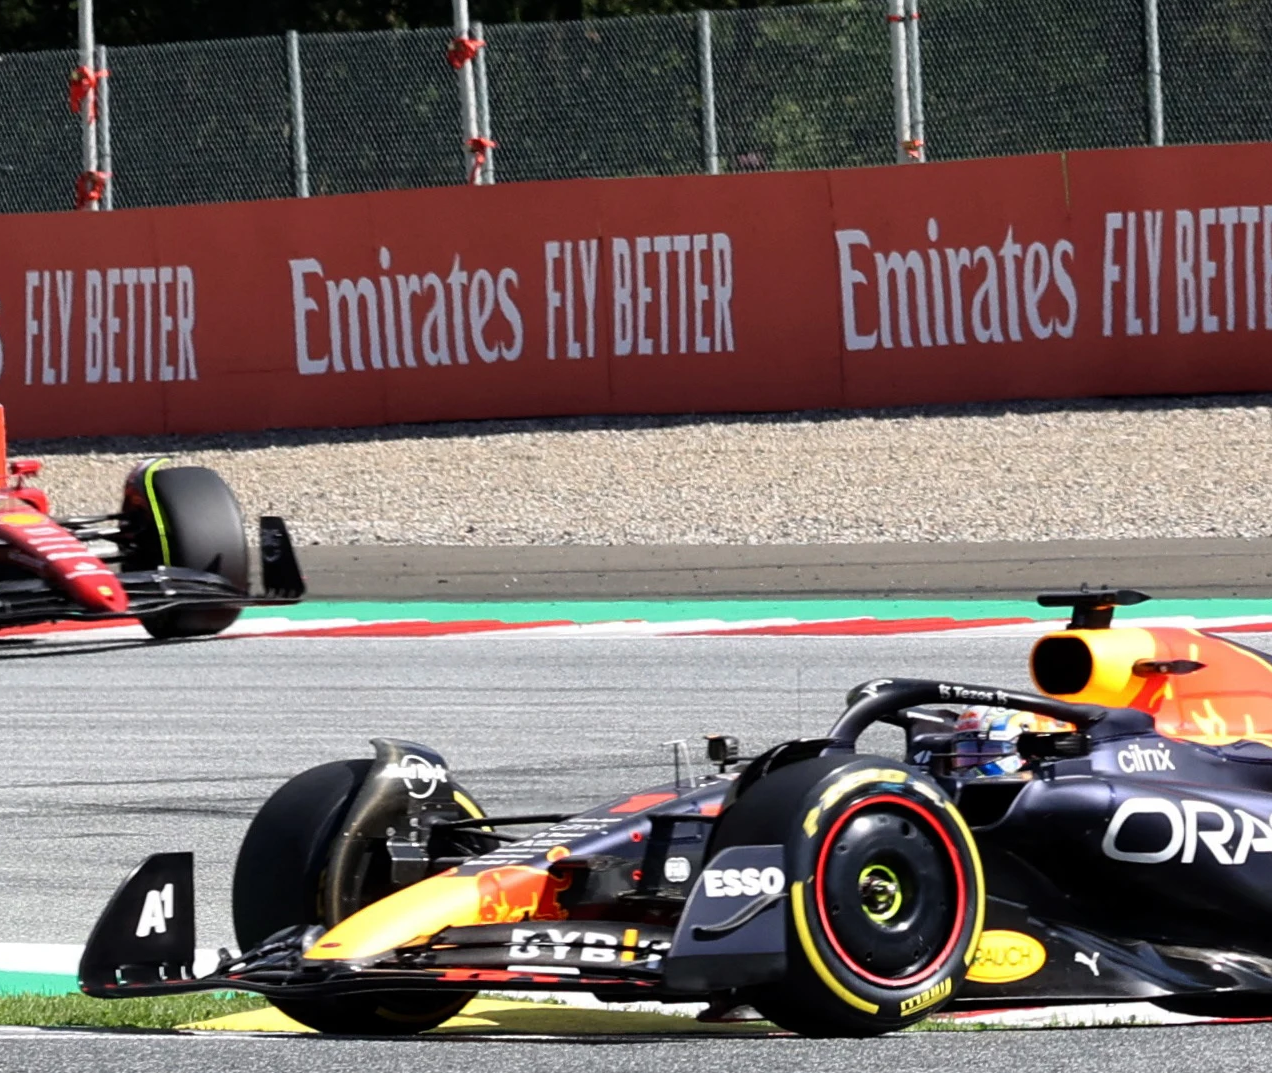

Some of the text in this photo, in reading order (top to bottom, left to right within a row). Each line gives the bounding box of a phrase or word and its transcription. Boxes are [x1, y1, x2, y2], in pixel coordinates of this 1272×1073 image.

[289, 233, 733, 374] Emirates FLY BETTER
[835, 218, 1077, 350] Emirates
[1104, 211, 1162, 335] FLY
[26, 271, 73, 384] FLY
[86, 266, 196, 382] BETTER
[953, 686, 994, 701] Tezos
[1117, 743, 1176, 773] citrix
[703, 866, 785, 898] ESSO
[135, 883, 174, 938] A1
